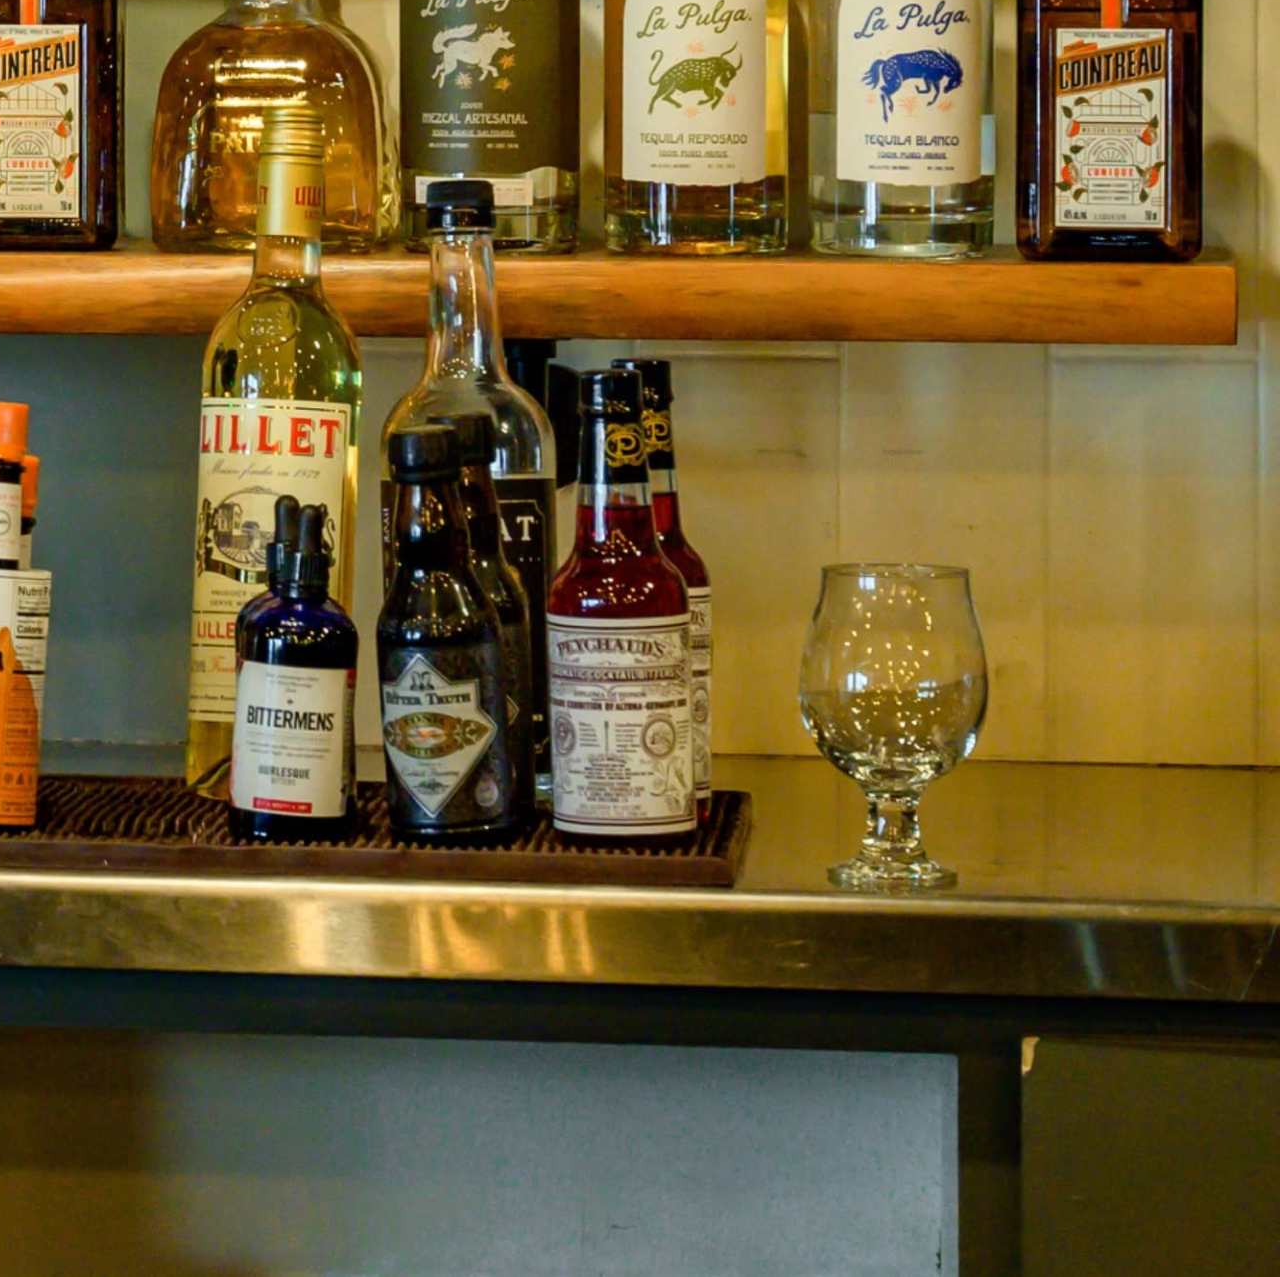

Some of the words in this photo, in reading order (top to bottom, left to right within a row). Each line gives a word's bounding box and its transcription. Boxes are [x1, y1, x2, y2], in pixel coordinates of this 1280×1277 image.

[635, 6, 668, 39] La
[853, 6, 889, 40] La
[1058, 42, 1163, 93] COINTREAU
[421, 112, 461, 125] MEZCAL
[465, 112, 528, 125] ARTESANAL
[639, 132, 684, 146] TEQUILA
[687, 132, 748, 146] REPOSADO
[864, 134, 912, 147] TEQUILA
[915, 134, 960, 147] BLANCO
[200, 412, 341, 459] LILLET
[246, 704, 335, 732] BITTERMENS
